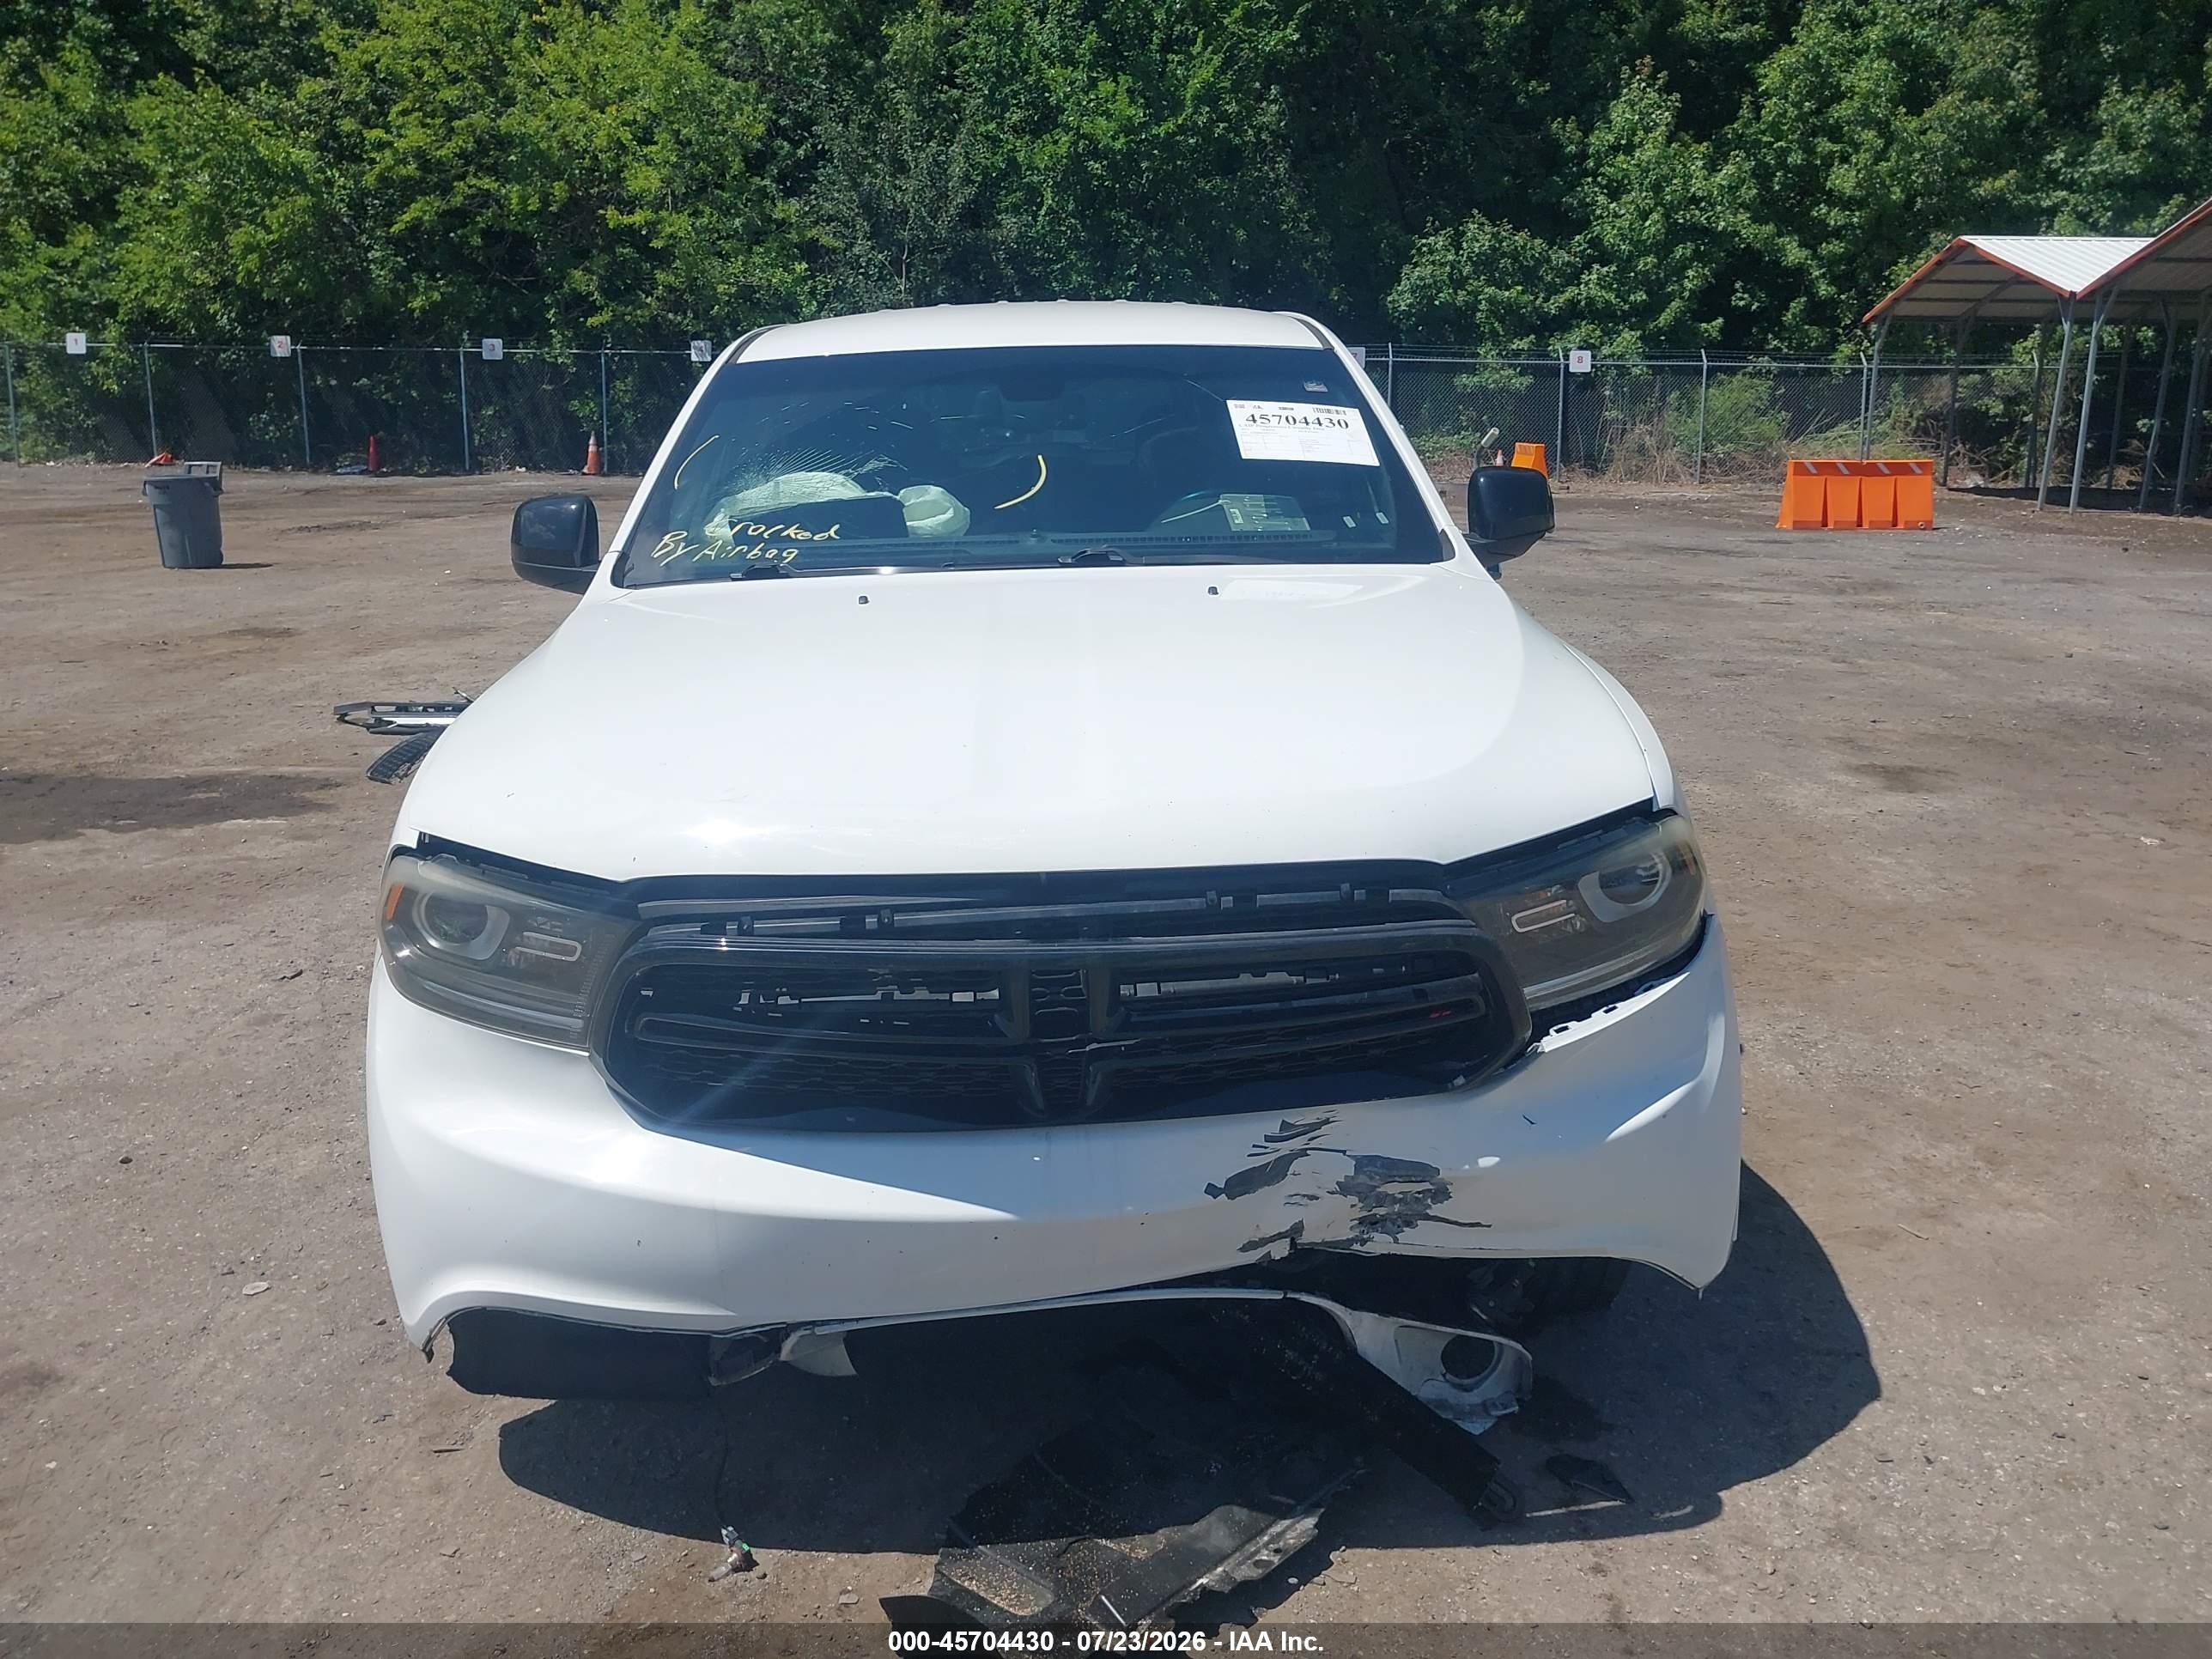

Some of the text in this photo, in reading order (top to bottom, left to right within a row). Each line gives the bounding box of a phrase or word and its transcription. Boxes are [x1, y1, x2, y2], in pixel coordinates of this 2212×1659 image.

[1577, 356, 1583, 364] 8
[1245, 413, 1349, 429] 45704430
[651, 531, 700, 567] By
